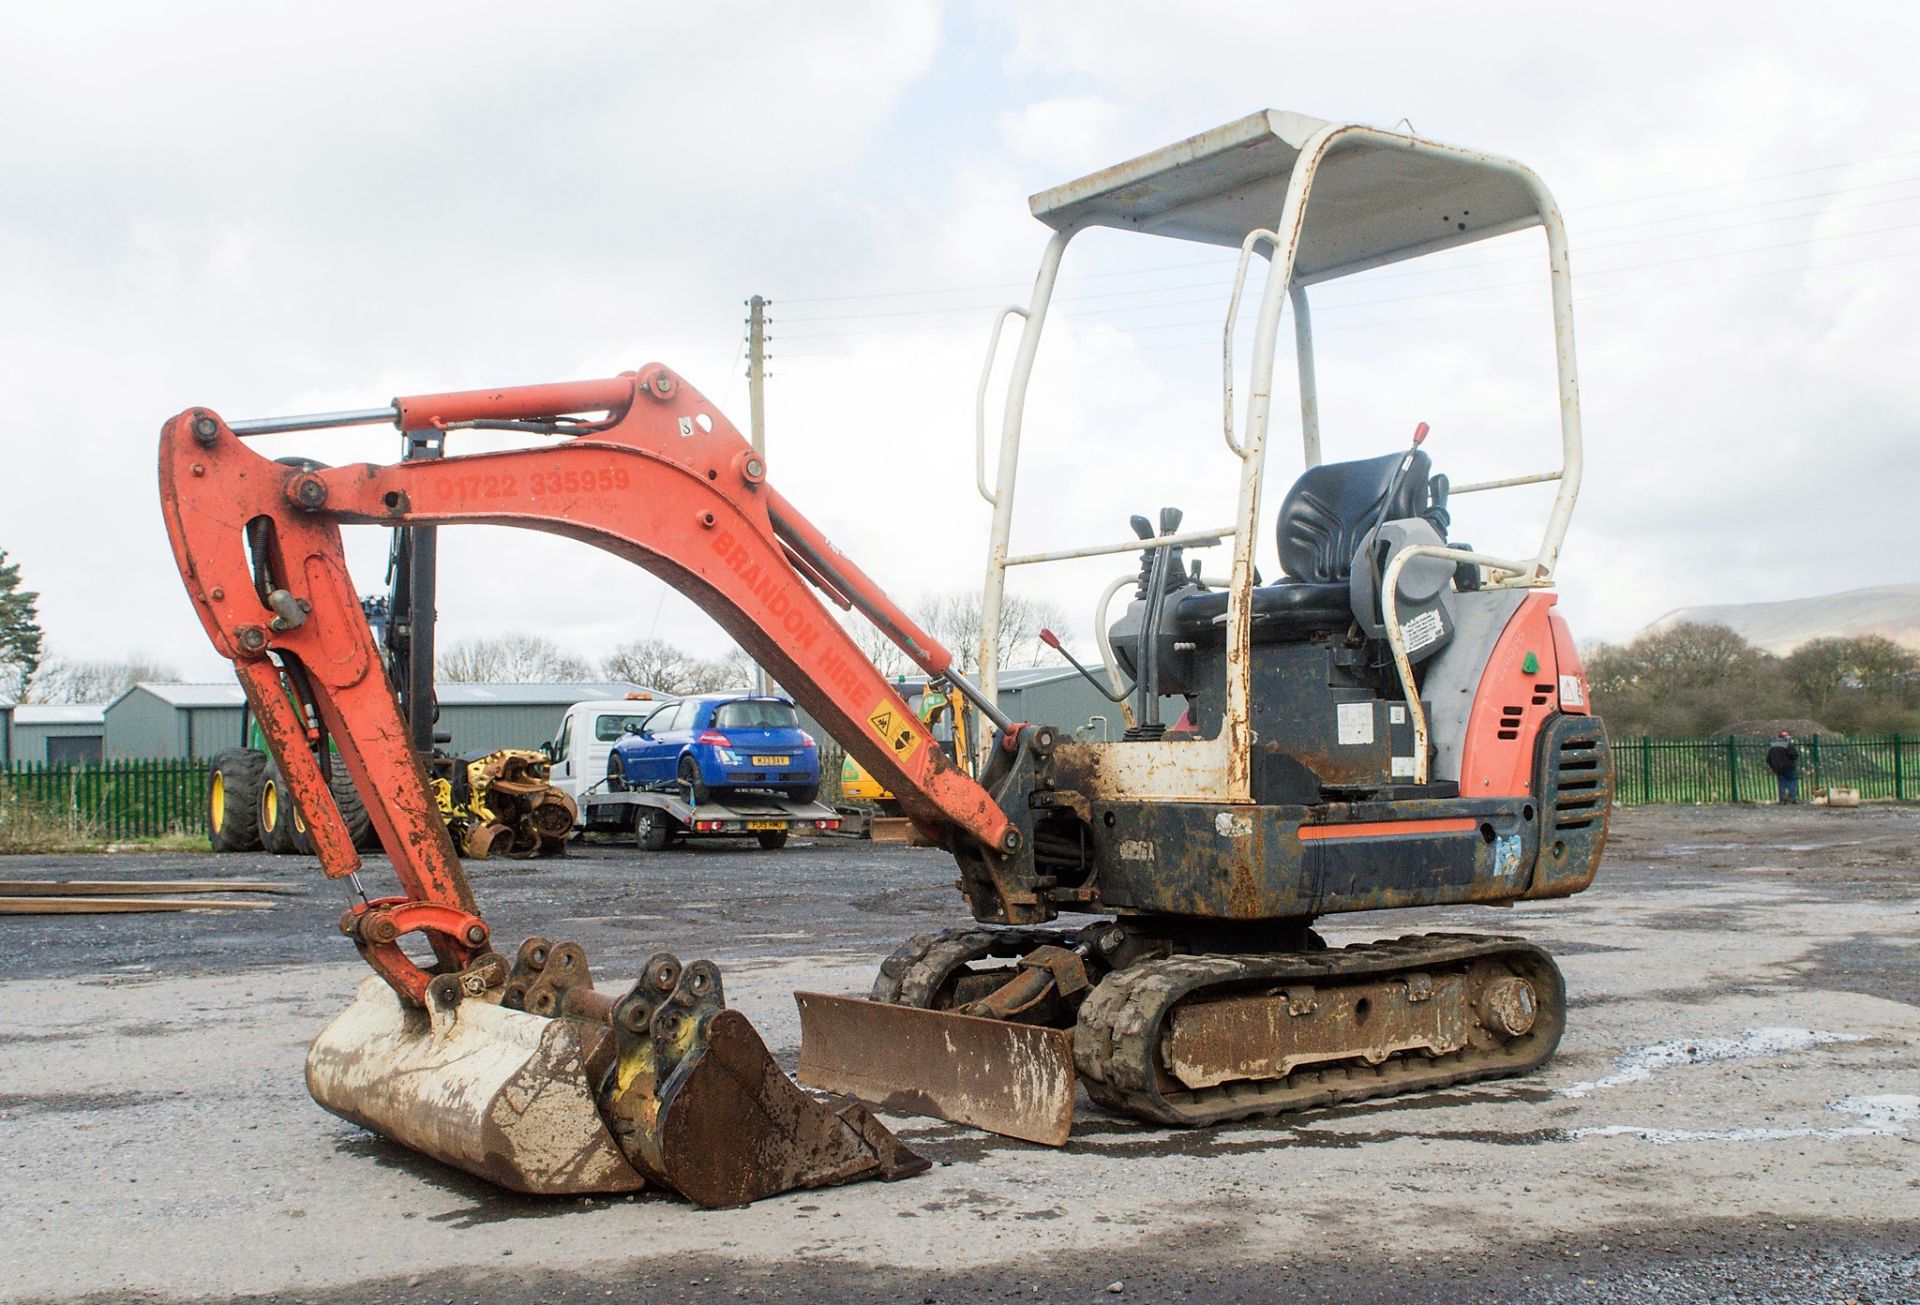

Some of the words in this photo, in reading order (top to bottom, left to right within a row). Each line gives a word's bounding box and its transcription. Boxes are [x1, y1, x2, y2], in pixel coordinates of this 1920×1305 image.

[435, 475, 517, 501] 01722
[530, 468, 629, 495] 335959
[712, 531, 819, 647] BRANDON
[817, 647, 872, 708] HIRE
